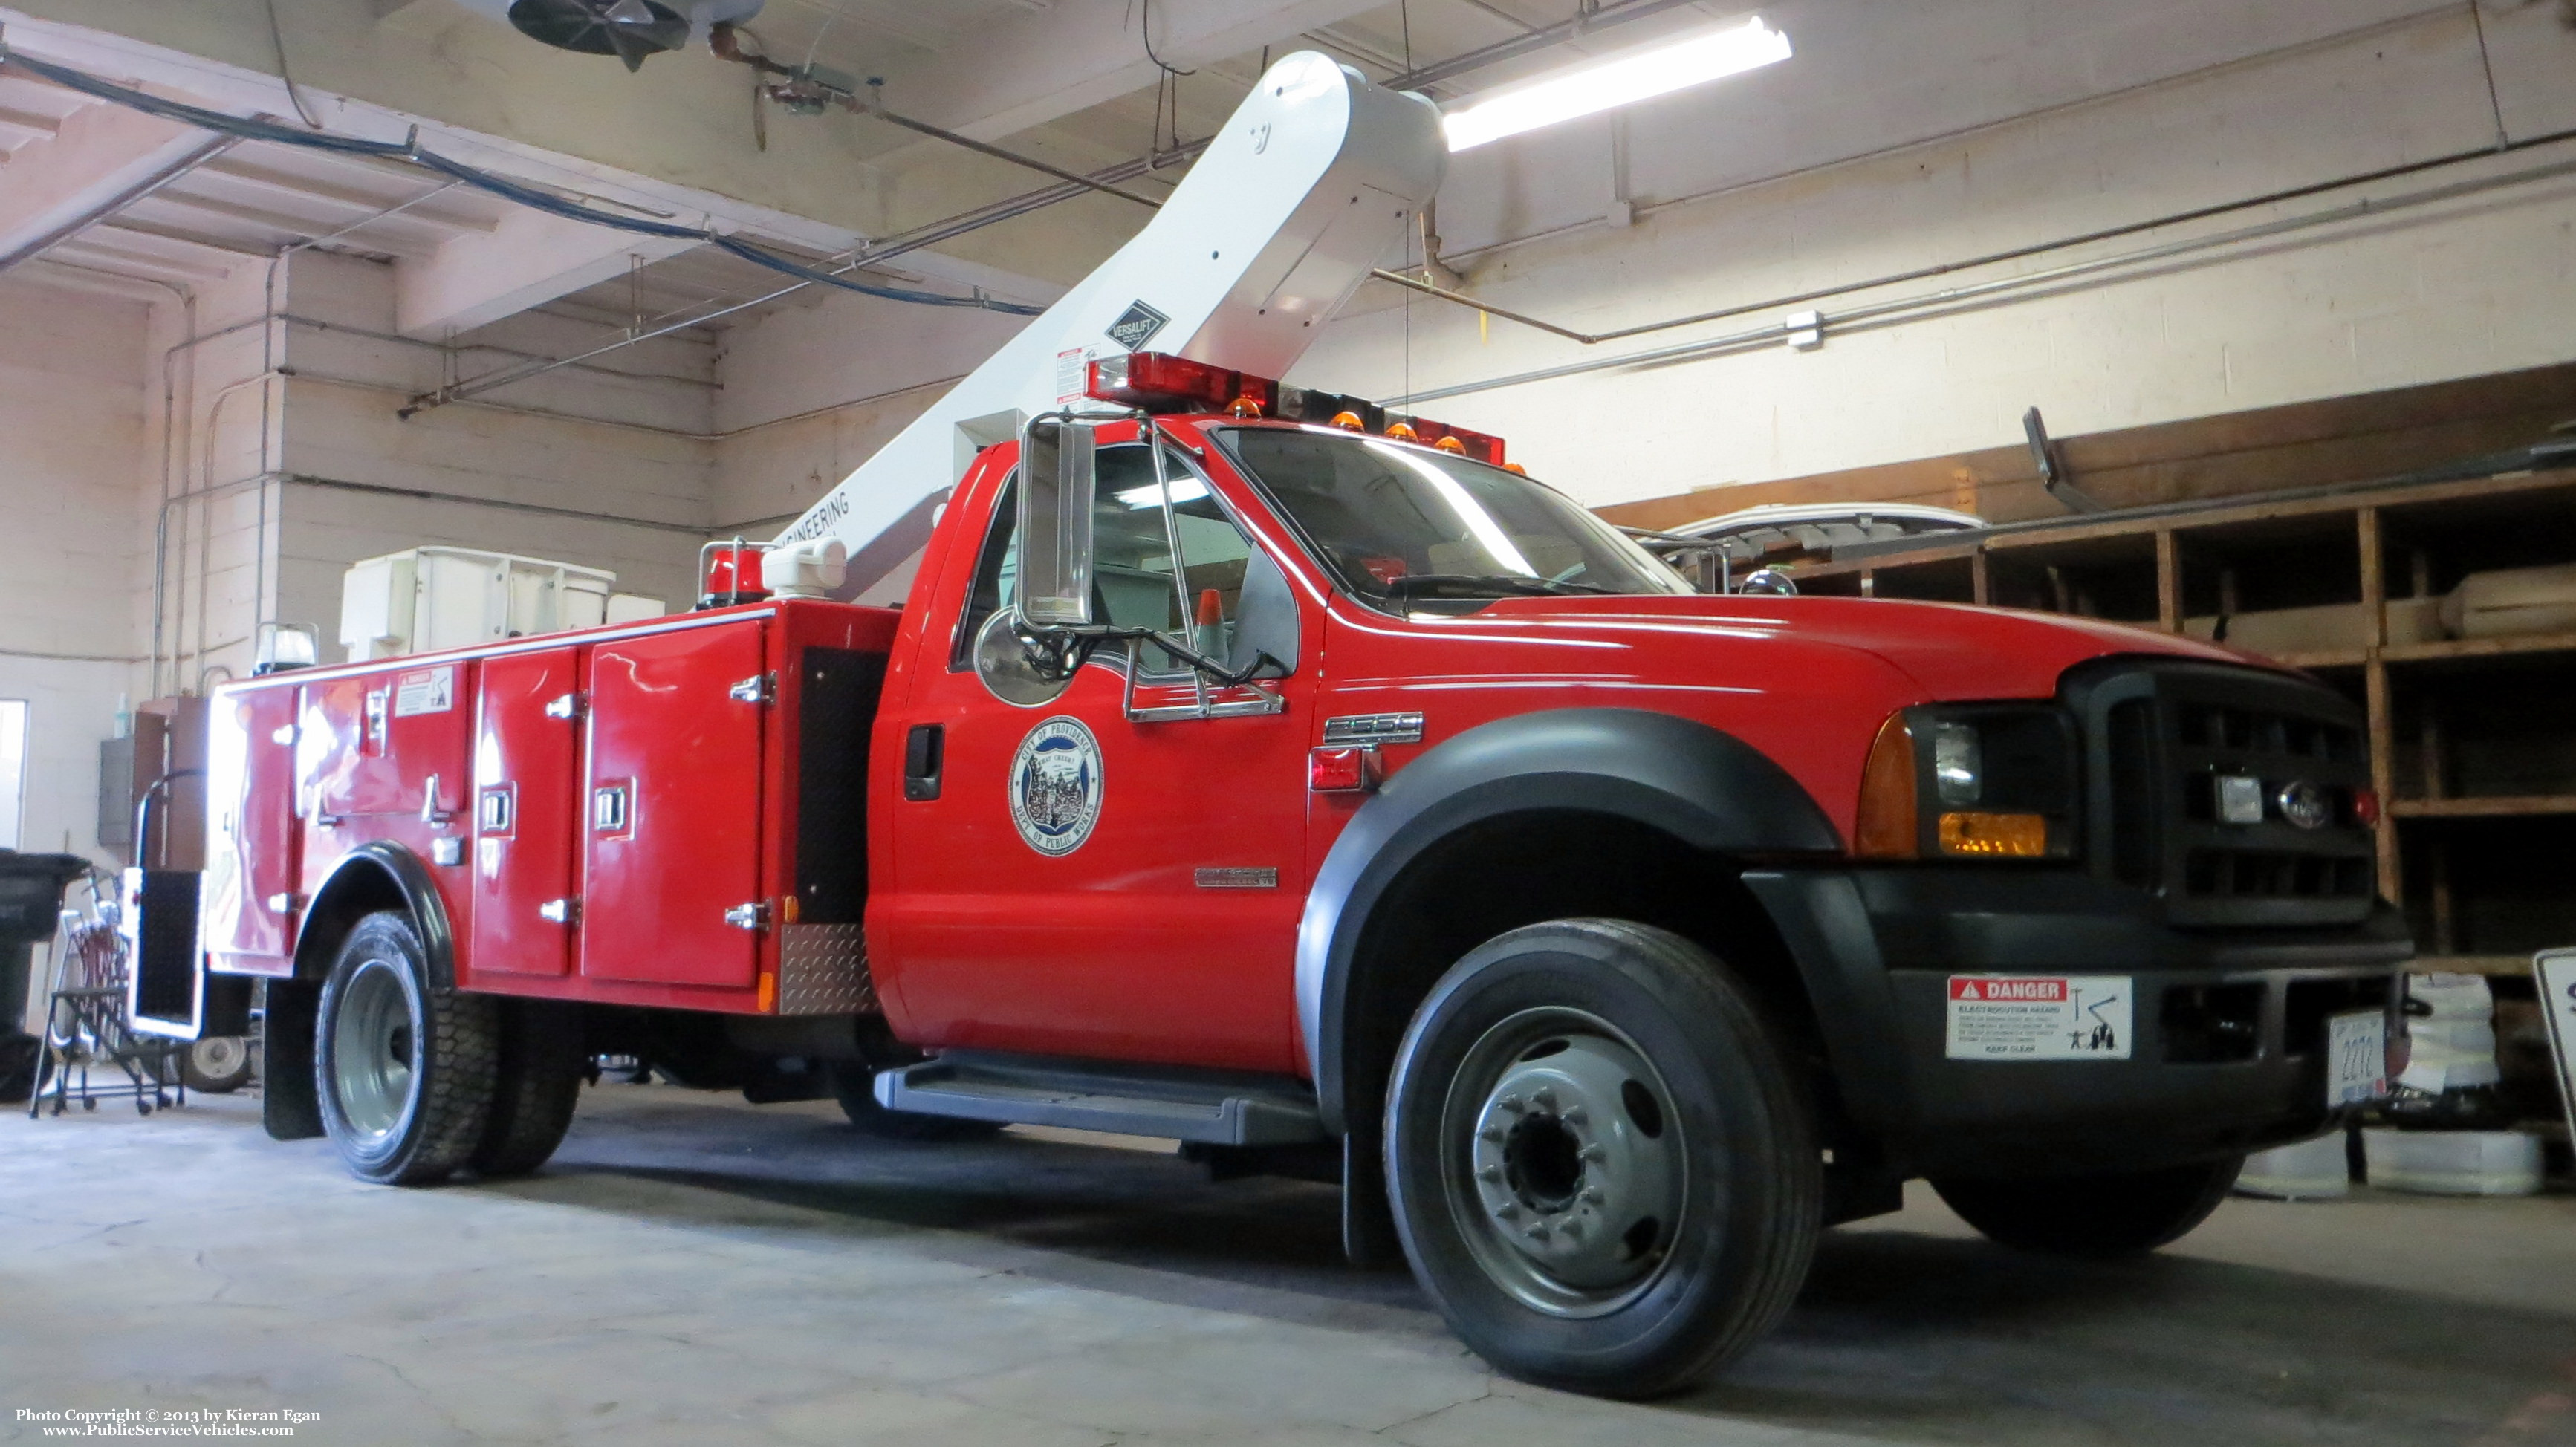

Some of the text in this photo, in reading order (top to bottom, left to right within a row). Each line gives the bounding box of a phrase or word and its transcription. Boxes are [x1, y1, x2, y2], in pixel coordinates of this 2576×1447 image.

[1113, 319, 1152, 338] VERSALIFT
[1021, 724, 1091, 761] CITY OF PROVIDENCE
[1033, 831, 1043, 843] OF
[1045, 834, 1072, 848] PUBLIC
[1075, 802, 1094, 837] WORKS
[1987, 982, 2060, 999] DANGER
